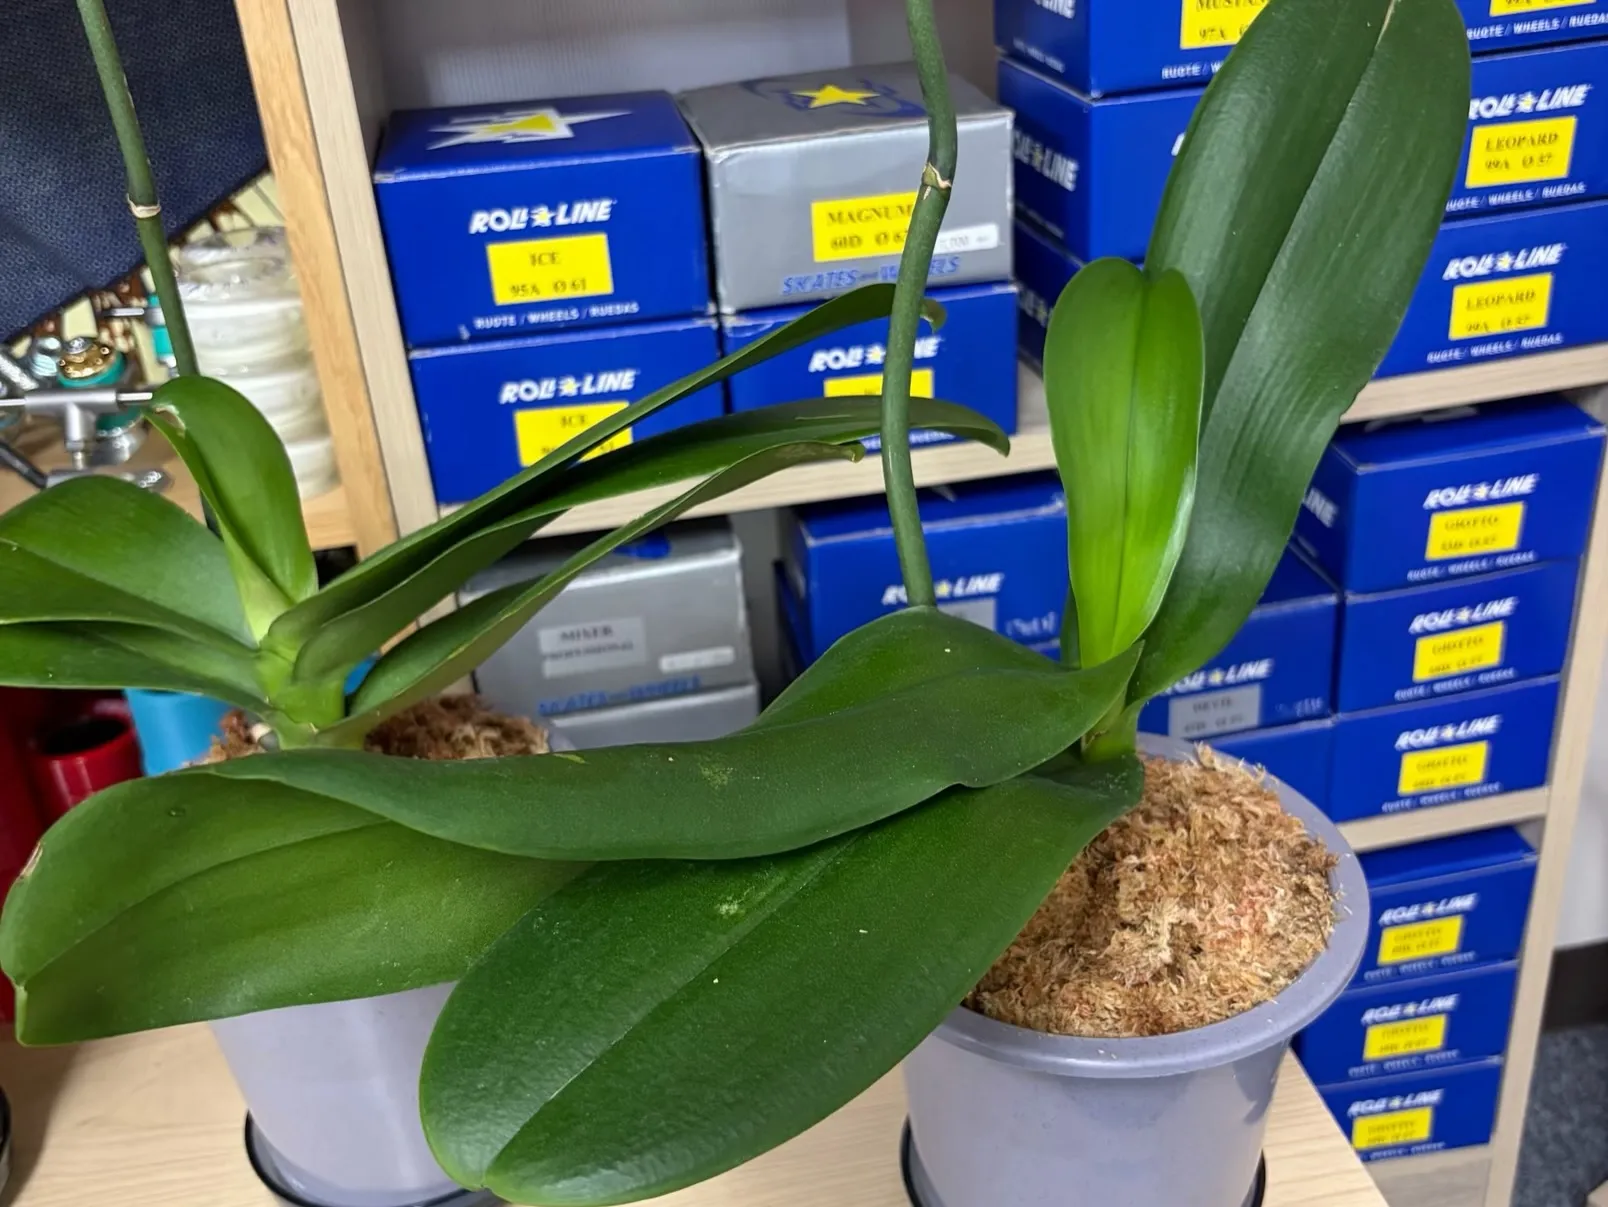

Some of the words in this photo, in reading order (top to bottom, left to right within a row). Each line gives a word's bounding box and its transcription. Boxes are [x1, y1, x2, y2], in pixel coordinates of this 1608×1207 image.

[1513, 18, 1560, 34] WHEELS
[1535, 84, 1588, 111] LINE
[1485, 132, 1558, 152] LEOPARD
[1042, 148, 1079, 191] LINE
[469, 209, 529, 234] ROLL
[555, 199, 612, 225] LINE
[826, 204, 914, 226] MAGNUM
[530, 252, 561, 267] ICE
[1442, 254, 1495, 280] ROLL
[1514, 243, 1565, 270] LINE
[510, 284, 541, 297] 95A
[571, 278, 587, 291] 61
[782, 268, 858, 296] SKATES
[1466, 288, 1545, 310] LEOPARD
[473, 314, 517, 329] RUOTE
[527, 307, 580, 324] WHEELS
[589, 302, 640, 318] RUEDAS
[808, 345, 864, 373] ROLL
[499, 377, 557, 404] ROLL
[581, 368, 637, 395] LINE
[1487, 473, 1539, 499] LINE
[1305, 487, 1339, 528] INE
[953, 572, 1004, 597] LINE
[1225, 657, 1274, 685] LINE
